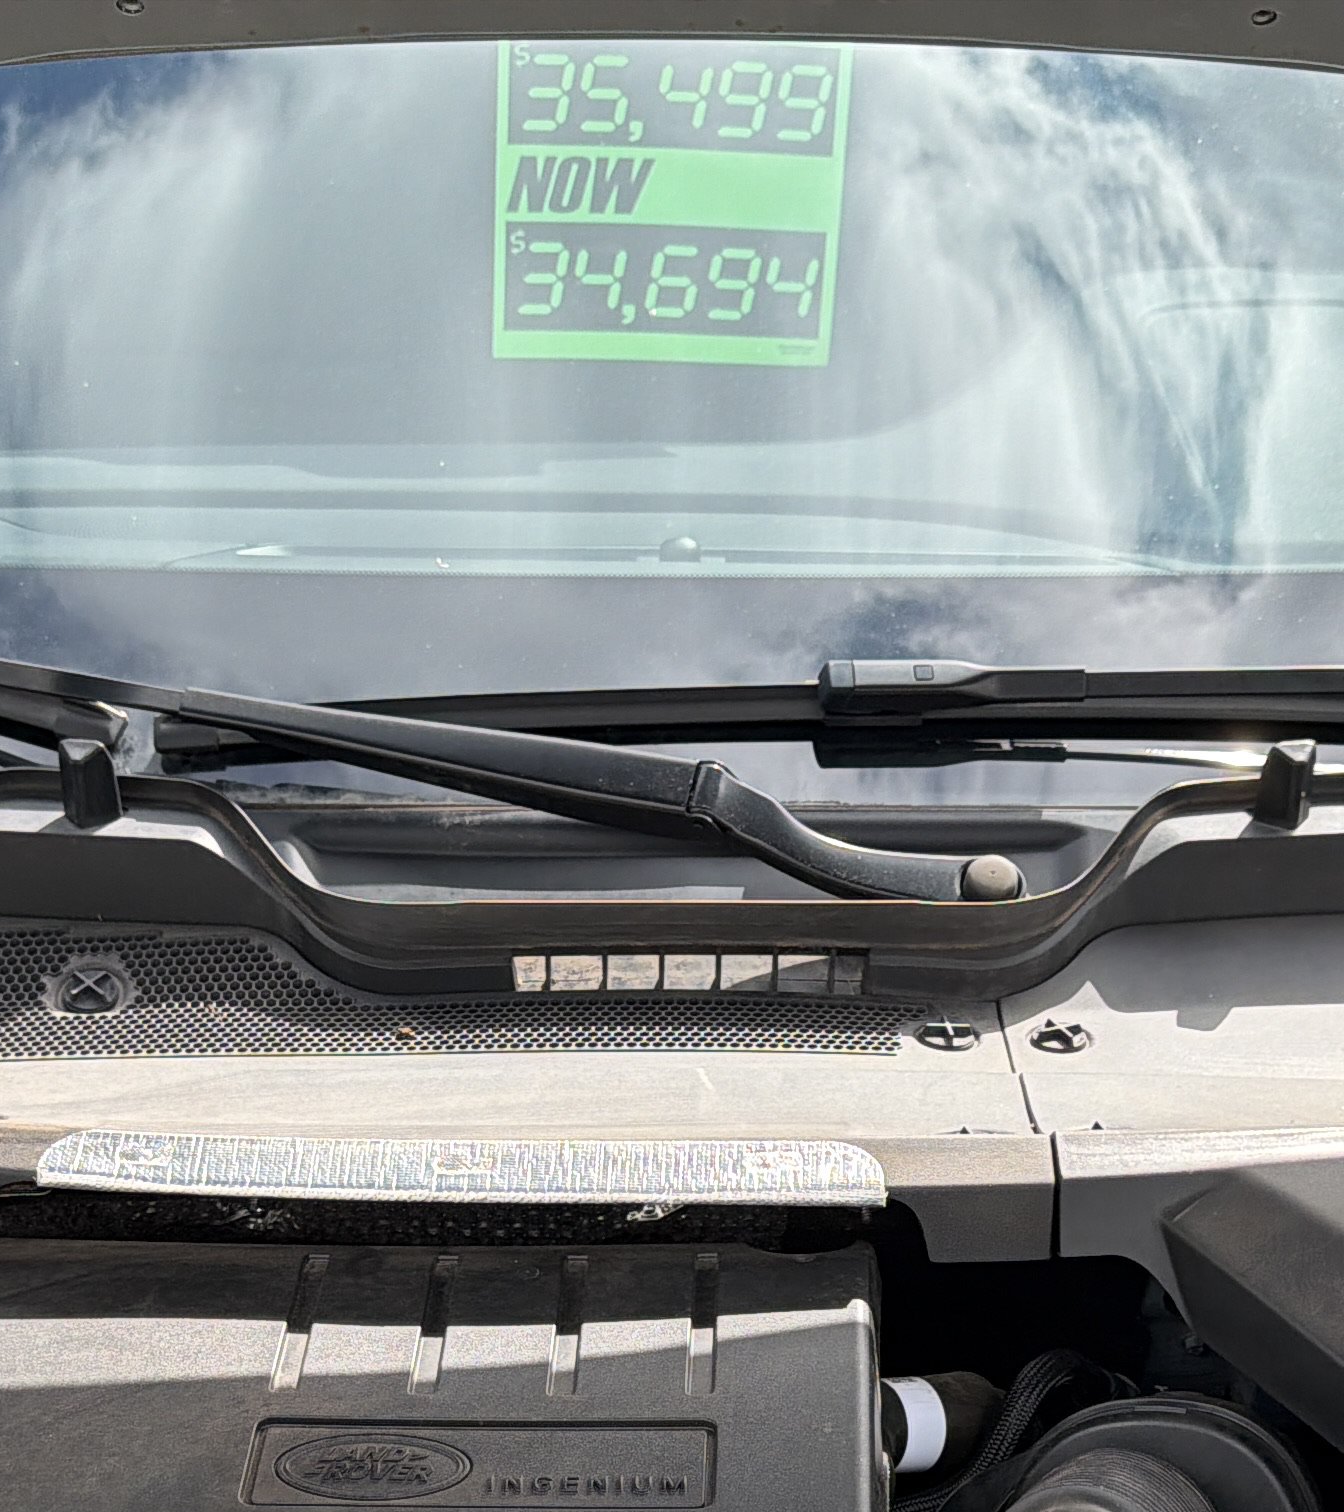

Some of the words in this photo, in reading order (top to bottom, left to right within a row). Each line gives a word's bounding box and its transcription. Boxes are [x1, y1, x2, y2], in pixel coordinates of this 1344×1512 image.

[507, 156, 656, 215] NOW
[317, 1445, 427, 1464] LAND
[304, 1463, 435, 1484] ROVER
[485, 1474, 689, 1496] INGENIUM
